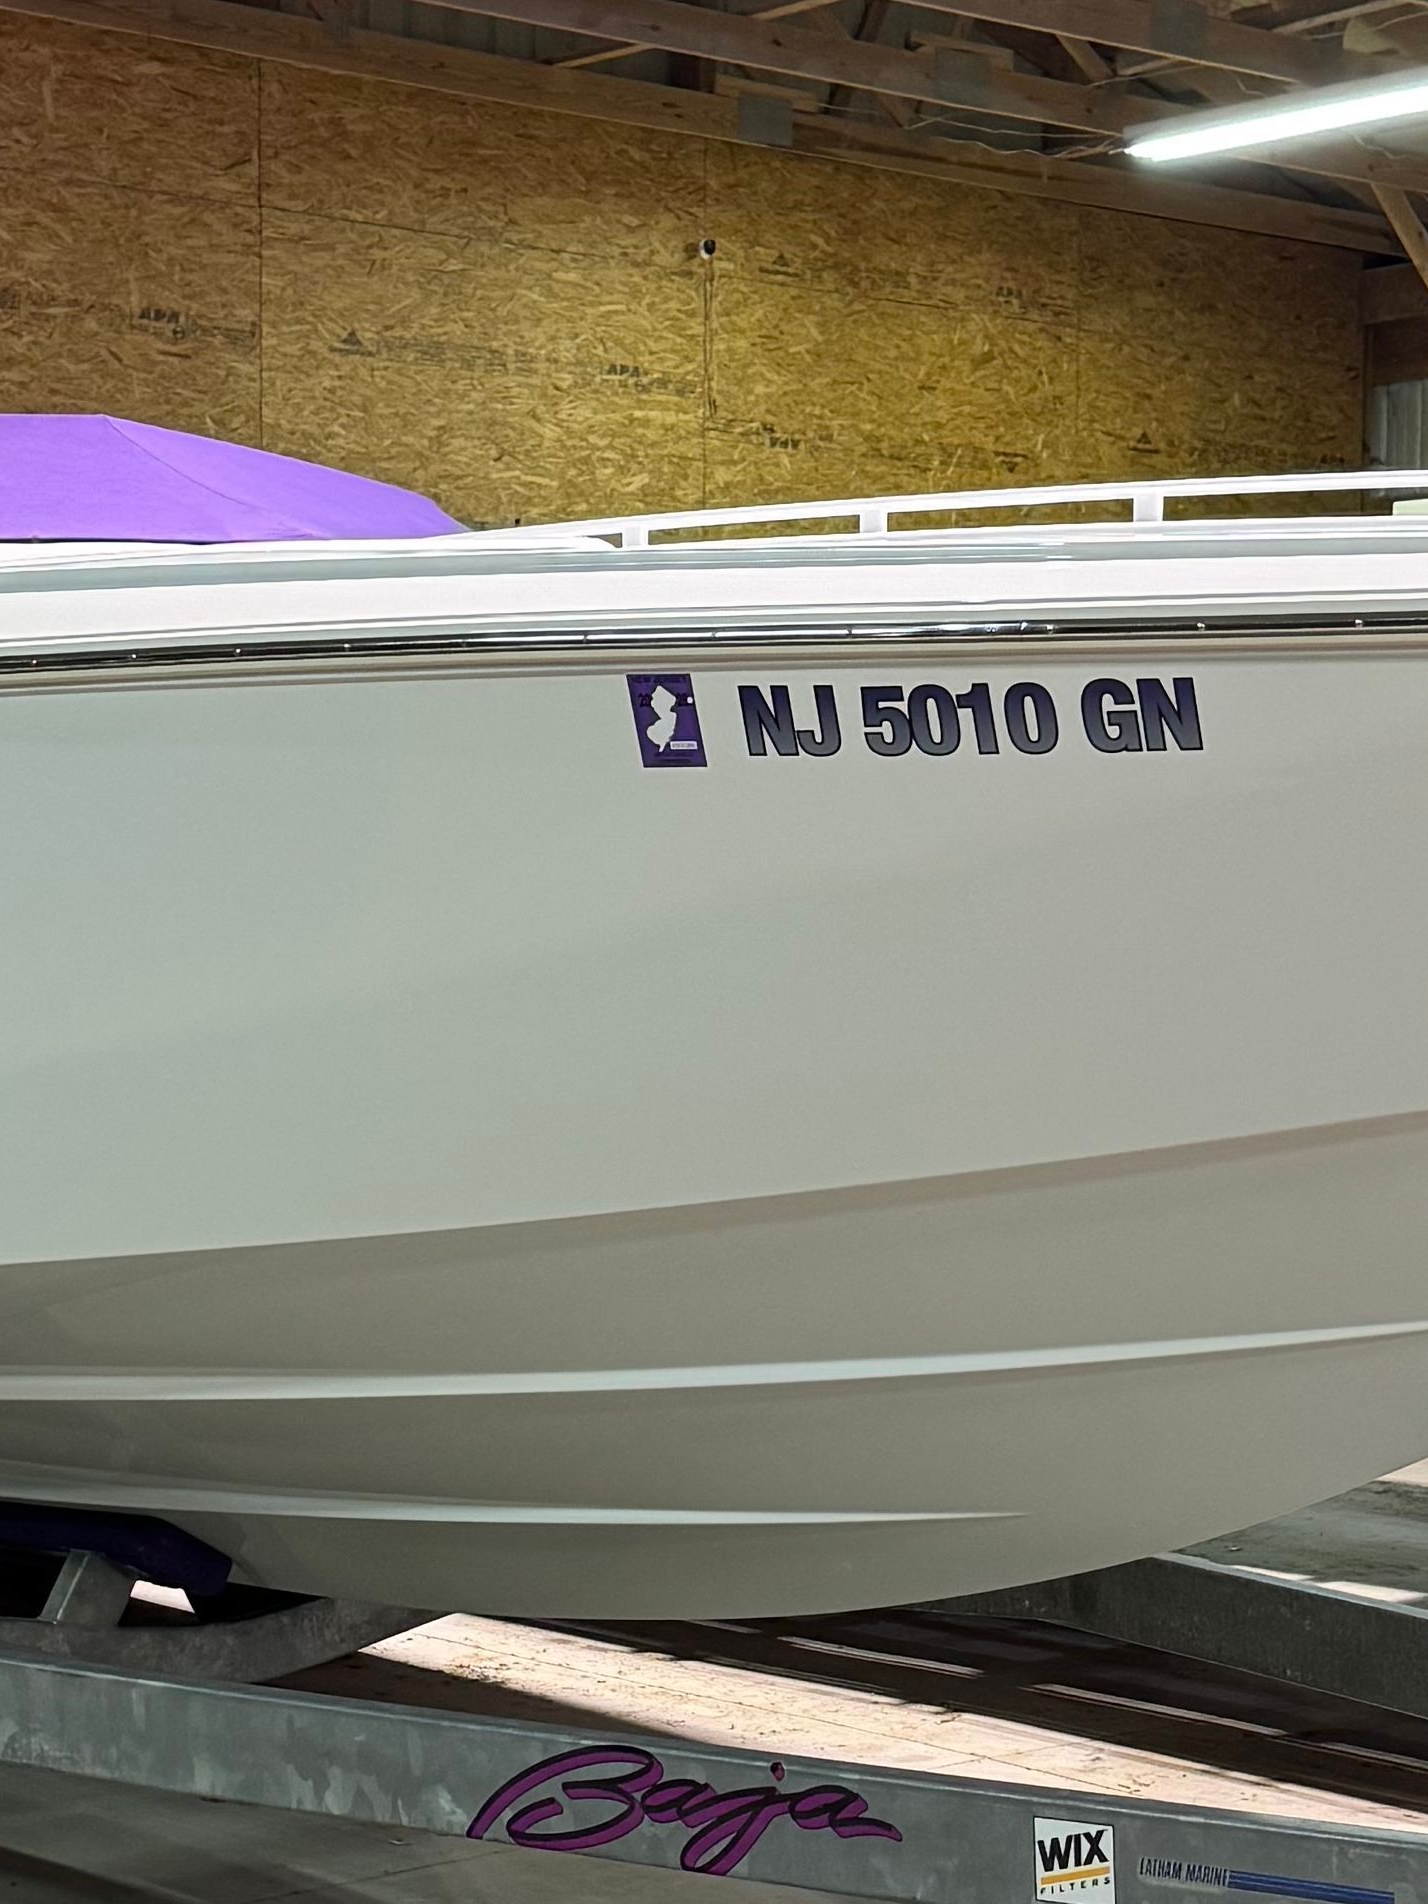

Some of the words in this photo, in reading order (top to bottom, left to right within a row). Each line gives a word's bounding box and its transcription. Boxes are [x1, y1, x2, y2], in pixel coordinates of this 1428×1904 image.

[737, 684, 842, 757] NJ
[860, 681, 1060, 757] 5010
[1080, 677, 1204, 754] GN
[466, 1744, 903, 1876] Baja
[1037, 1828, 1109, 1873] WIX
[1139, 1857, 1183, 1880] LATHAM
[1184, 1864, 1228, 1887] MARINE
[1040, 1876, 1111, 1895] FILTERS
